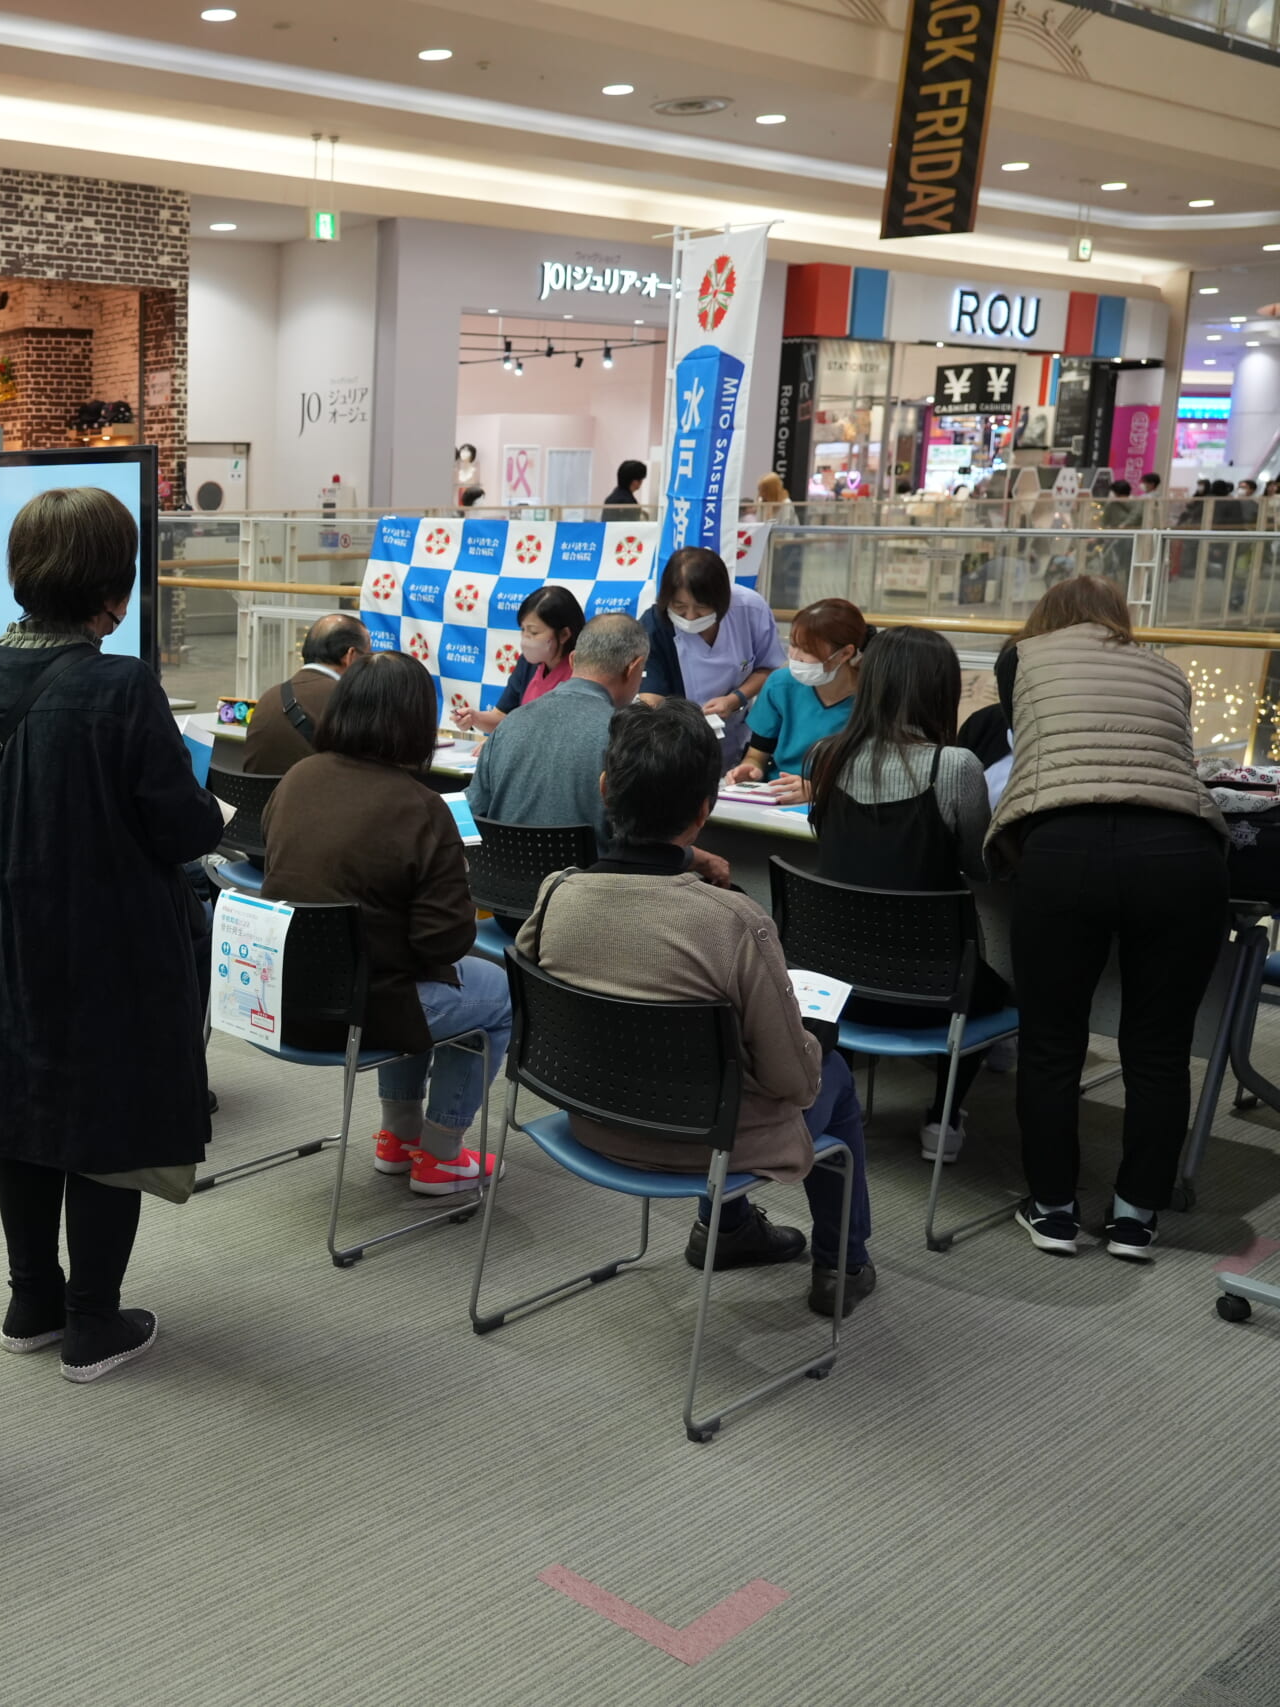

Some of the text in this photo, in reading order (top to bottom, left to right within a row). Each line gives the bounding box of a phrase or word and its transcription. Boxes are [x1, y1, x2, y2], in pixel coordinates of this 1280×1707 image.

[902, 78, 972, 233] FRIDAY
[827, 361, 879, 374] STATIONERY
[779, 384, 793, 425] Rock
[934, 403, 977, 414] CASHIER
[979, 402, 1011, 413] CASHIER
[703, 376, 739, 537] MITO SAISEIKAI
